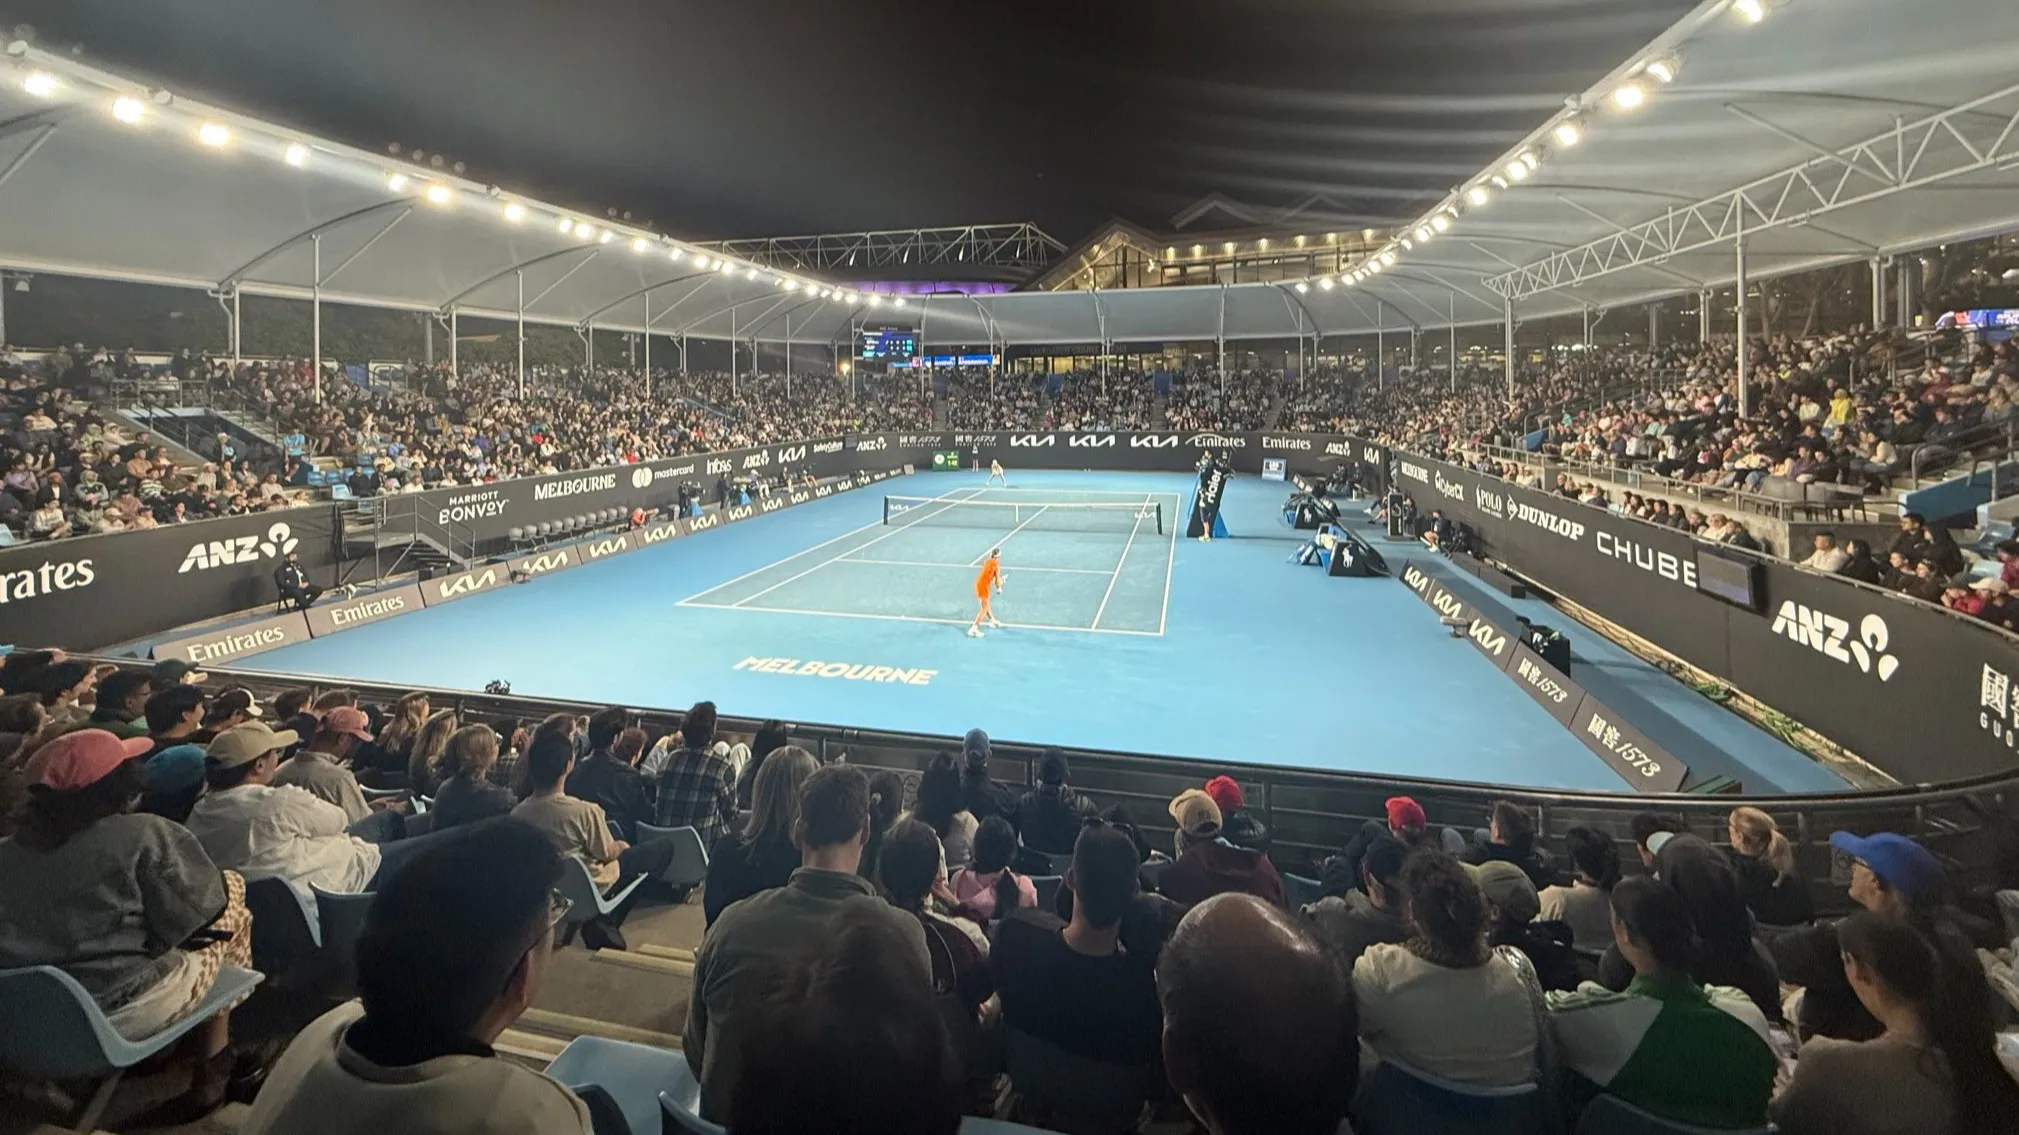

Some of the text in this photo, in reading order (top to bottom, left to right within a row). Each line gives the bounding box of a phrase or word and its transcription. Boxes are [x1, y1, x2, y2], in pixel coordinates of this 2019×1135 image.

[856, 440, 876, 451] ANZ
[1010, 434, 1055, 447] KIA
[1069, 434, 1115, 447] KIA
[1130, 434, 1178, 448] KIA
[1194, 436, 1246, 447] Emirates
[1262, 436, 1311, 450] Emirates
[1325, 442, 1343, 455] ANZ
[743, 454, 761, 469] ANZ
[778, 445, 806, 463] KIA
[1364, 446, 1379, 465] KIA
[654, 464, 694, 479] mastercard
[535, 473, 616, 500] MELBOURNE
[1205, 468, 1222, 504] Haier
[449, 490, 498, 506] MARRIOTT
[762, 498, 783, 512] KIA
[791, 491, 809, 504] KIA
[1480, 489, 1502, 512] POLO
[439, 499, 507, 525] BONVOY
[690, 513, 717, 531] KIA
[728, 505, 753, 521] KIA
[1519, 505, 1585, 541] DUNLOP
[644, 524, 677, 543] KIA
[178, 535, 259, 573] ANZ
[589, 536, 627, 558] KIA
[523, 551, 568, 574] KIA
[439, 569, 496, 598] KIA
[1404, 566, 1429, 592] KIA
[331, 595, 405, 625] Emirates
[1433, 588, 1462, 618] KIA
[1469, 618, 1507, 656] KIA
[1771, 600, 1850, 664] ANZ
[187, 625, 285, 662] Emirates
[733, 656, 938, 685] MELBOURNE
[1980, 711, 2019, 755] GUO
